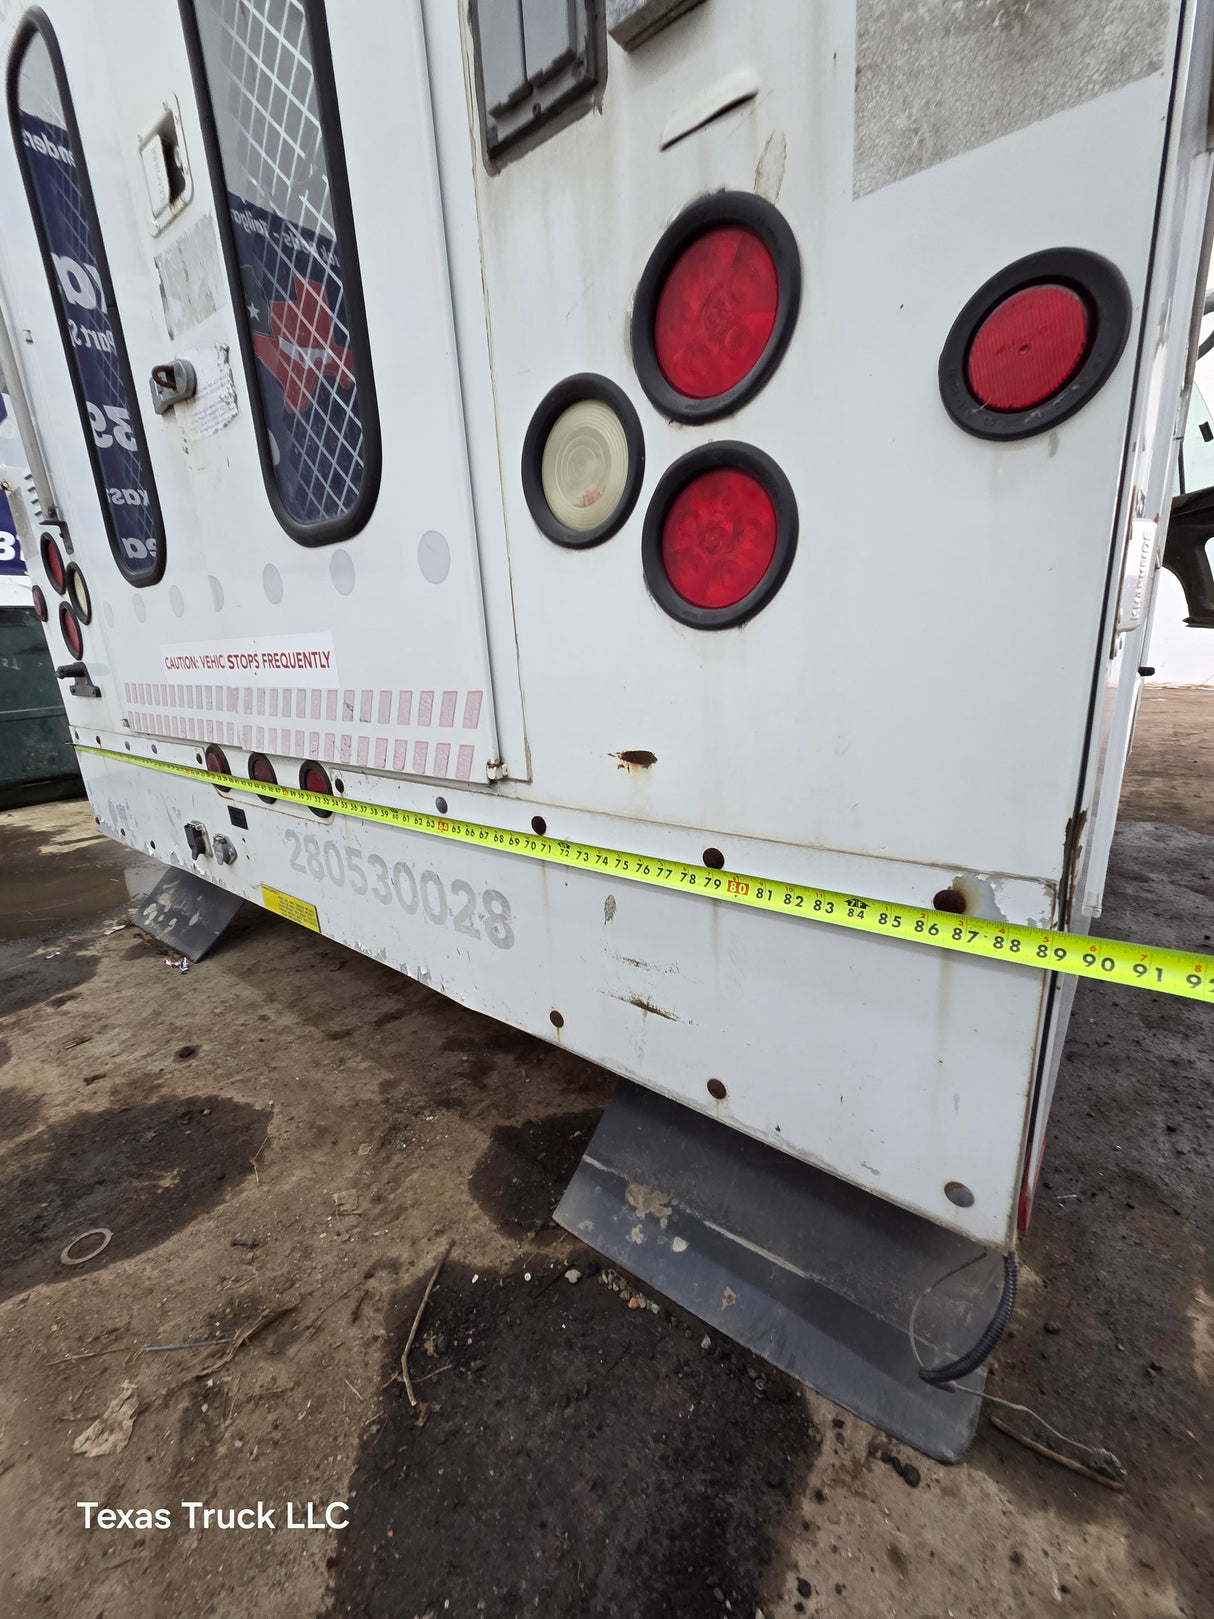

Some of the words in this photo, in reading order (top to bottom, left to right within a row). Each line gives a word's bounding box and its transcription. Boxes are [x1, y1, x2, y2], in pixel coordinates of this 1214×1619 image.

[165, 656, 199, 670] CAUTION:
[200, 654, 226, 669] VEHIC
[227, 653, 260, 669] STOPS
[261, 651, 331, 669] FREQUENTLY
[285, 828, 514, 950] 280530028
[350, 803, 358, 811] 56
[381, 810, 389, 818] 59
[403, 814, 410, 822] 61
[414, 817, 423, 825] 62
[426, 820, 435, 828] 63
[452, 825, 461, 834] 65
[466, 828, 475, 837] 66
[479, 830, 489, 839] 67
[494, 834, 504, 843] 68
[509, 837, 520, 846] 69
[524, 840, 536, 850] 70
[541, 844, 552, 853] 71
[576, 851, 589, 861] 73
[595, 855, 608, 866] 74
[615, 858, 629, 870] 75
[636, 863, 650, 875] 76
[657, 867, 672, 879] 77
[680, 872, 696, 884] 78
[704, 877, 722, 889] 79
[729, 882, 748, 894] 80
[756, 887, 772, 901] 81
[784, 894, 804, 907] 82
[813, 899, 834, 914] 83
[847, 908, 864, 919] 84
[878, 913, 902, 928] 85
[914, 920, 939, 936] 86
[952, 928, 979, 943] 87
[993, 935, 1021, 953] 88
[1036, 944, 1067, 962] 89
[1082, 954, 1115, 972] 90
[1132, 963, 1163, 982] 91
